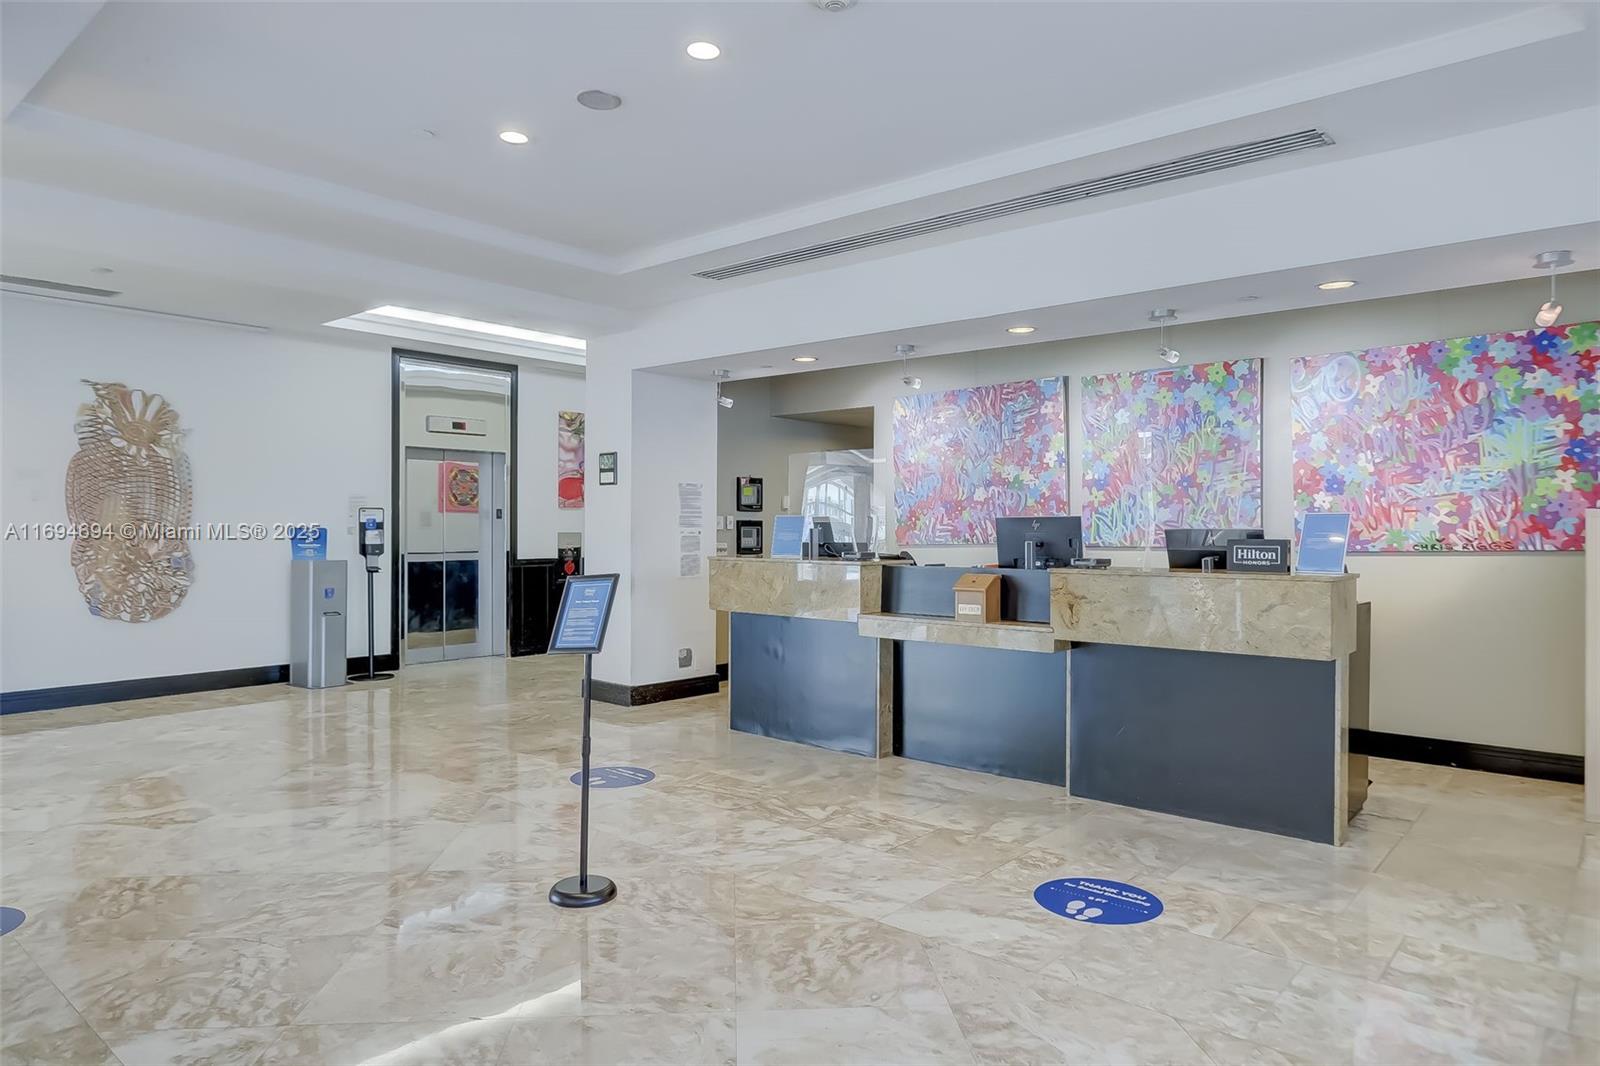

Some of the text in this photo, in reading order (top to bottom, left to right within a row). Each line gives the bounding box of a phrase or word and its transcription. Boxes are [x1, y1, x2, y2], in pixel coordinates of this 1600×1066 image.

[1237, 548, 1277, 560] Hilton
[1079, 880, 1148, 900] THANK YOU
